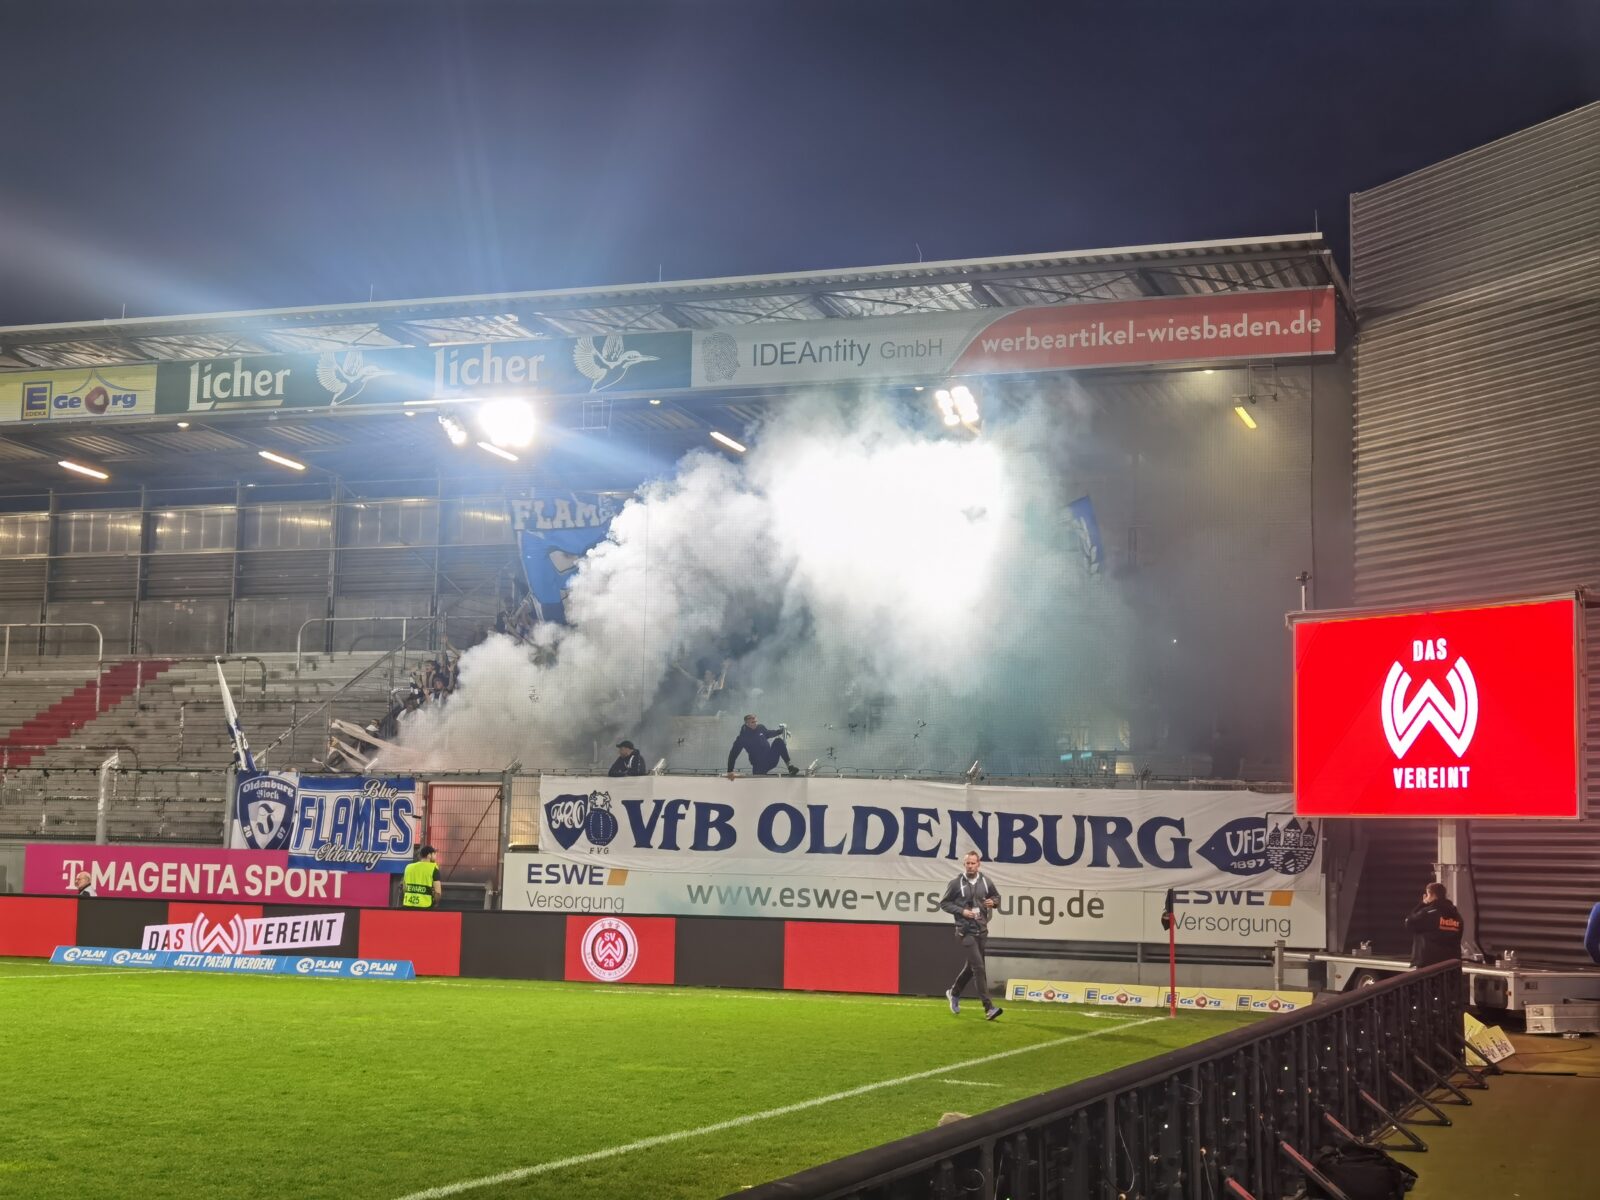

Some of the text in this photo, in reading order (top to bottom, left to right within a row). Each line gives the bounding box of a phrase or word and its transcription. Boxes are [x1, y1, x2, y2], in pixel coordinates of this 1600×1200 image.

[981, 310, 1322, 353] werbeartikel-wiesbaden.de
[753, 338, 943, 367] IDEAntity GmbH
[432, 344, 545, 397] Licher
[187, 358, 291, 412] Licher
[1412, 638, 1447, 662] DAS
[243, 780, 294, 797] Oldenburg
[360, 779, 398, 797] Blue
[1393, 767, 1470, 788] VEREINT
[291, 795, 416, 854] FLAMES
[621, 799, 1193, 870] VfB OLDENBURG
[1225, 828, 1266, 857] VfB
[315, 842, 382, 871] Oldenburg
[1230, 859, 1266, 869] 1897
[91, 860, 238, 895] MAGENTA
[245, 865, 348, 898] SPORT
[527, 864, 604, 886] ESWE
[526, 891, 625, 912] Versorgung
[686, 884, 1105, 926] www.eswe-versung.de
[149, 929, 185, 951] DAS
[252, 919, 337, 945] VEREINT
[1173, 911, 1291, 937] Versorgung
[604, 932, 616, 941] SV
[82, 949, 107, 958] PLAN
[131, 952, 156, 961] PLAN
[174, 954, 204, 967] JETZT
[233, 956, 277, 970] WERDEN!
[315, 960, 343, 969] PLAN
[603, 959, 615, 967] 26
[370, 962, 398, 972] PLAN
